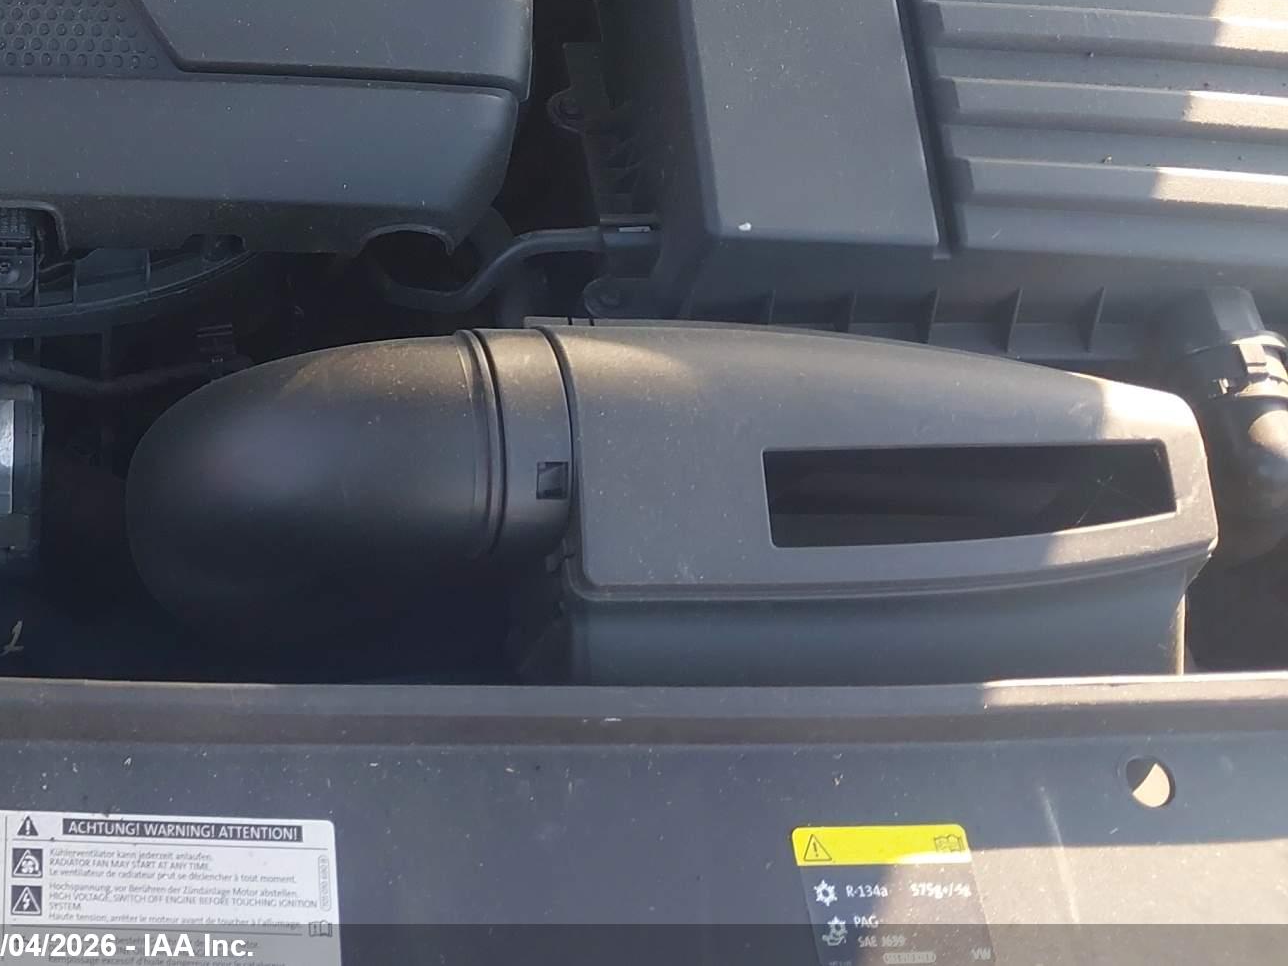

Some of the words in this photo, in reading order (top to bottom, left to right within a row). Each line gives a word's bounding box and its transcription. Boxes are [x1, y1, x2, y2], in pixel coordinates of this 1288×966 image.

[69, 821, 139, 835] ACHTUNG!
[144, 824, 215, 838] WARNING!
[218, 825, 297, 840] ATTENTION!
[846, 884, 888, 898] R-134a
[853, 916, 878, 928] PAG
